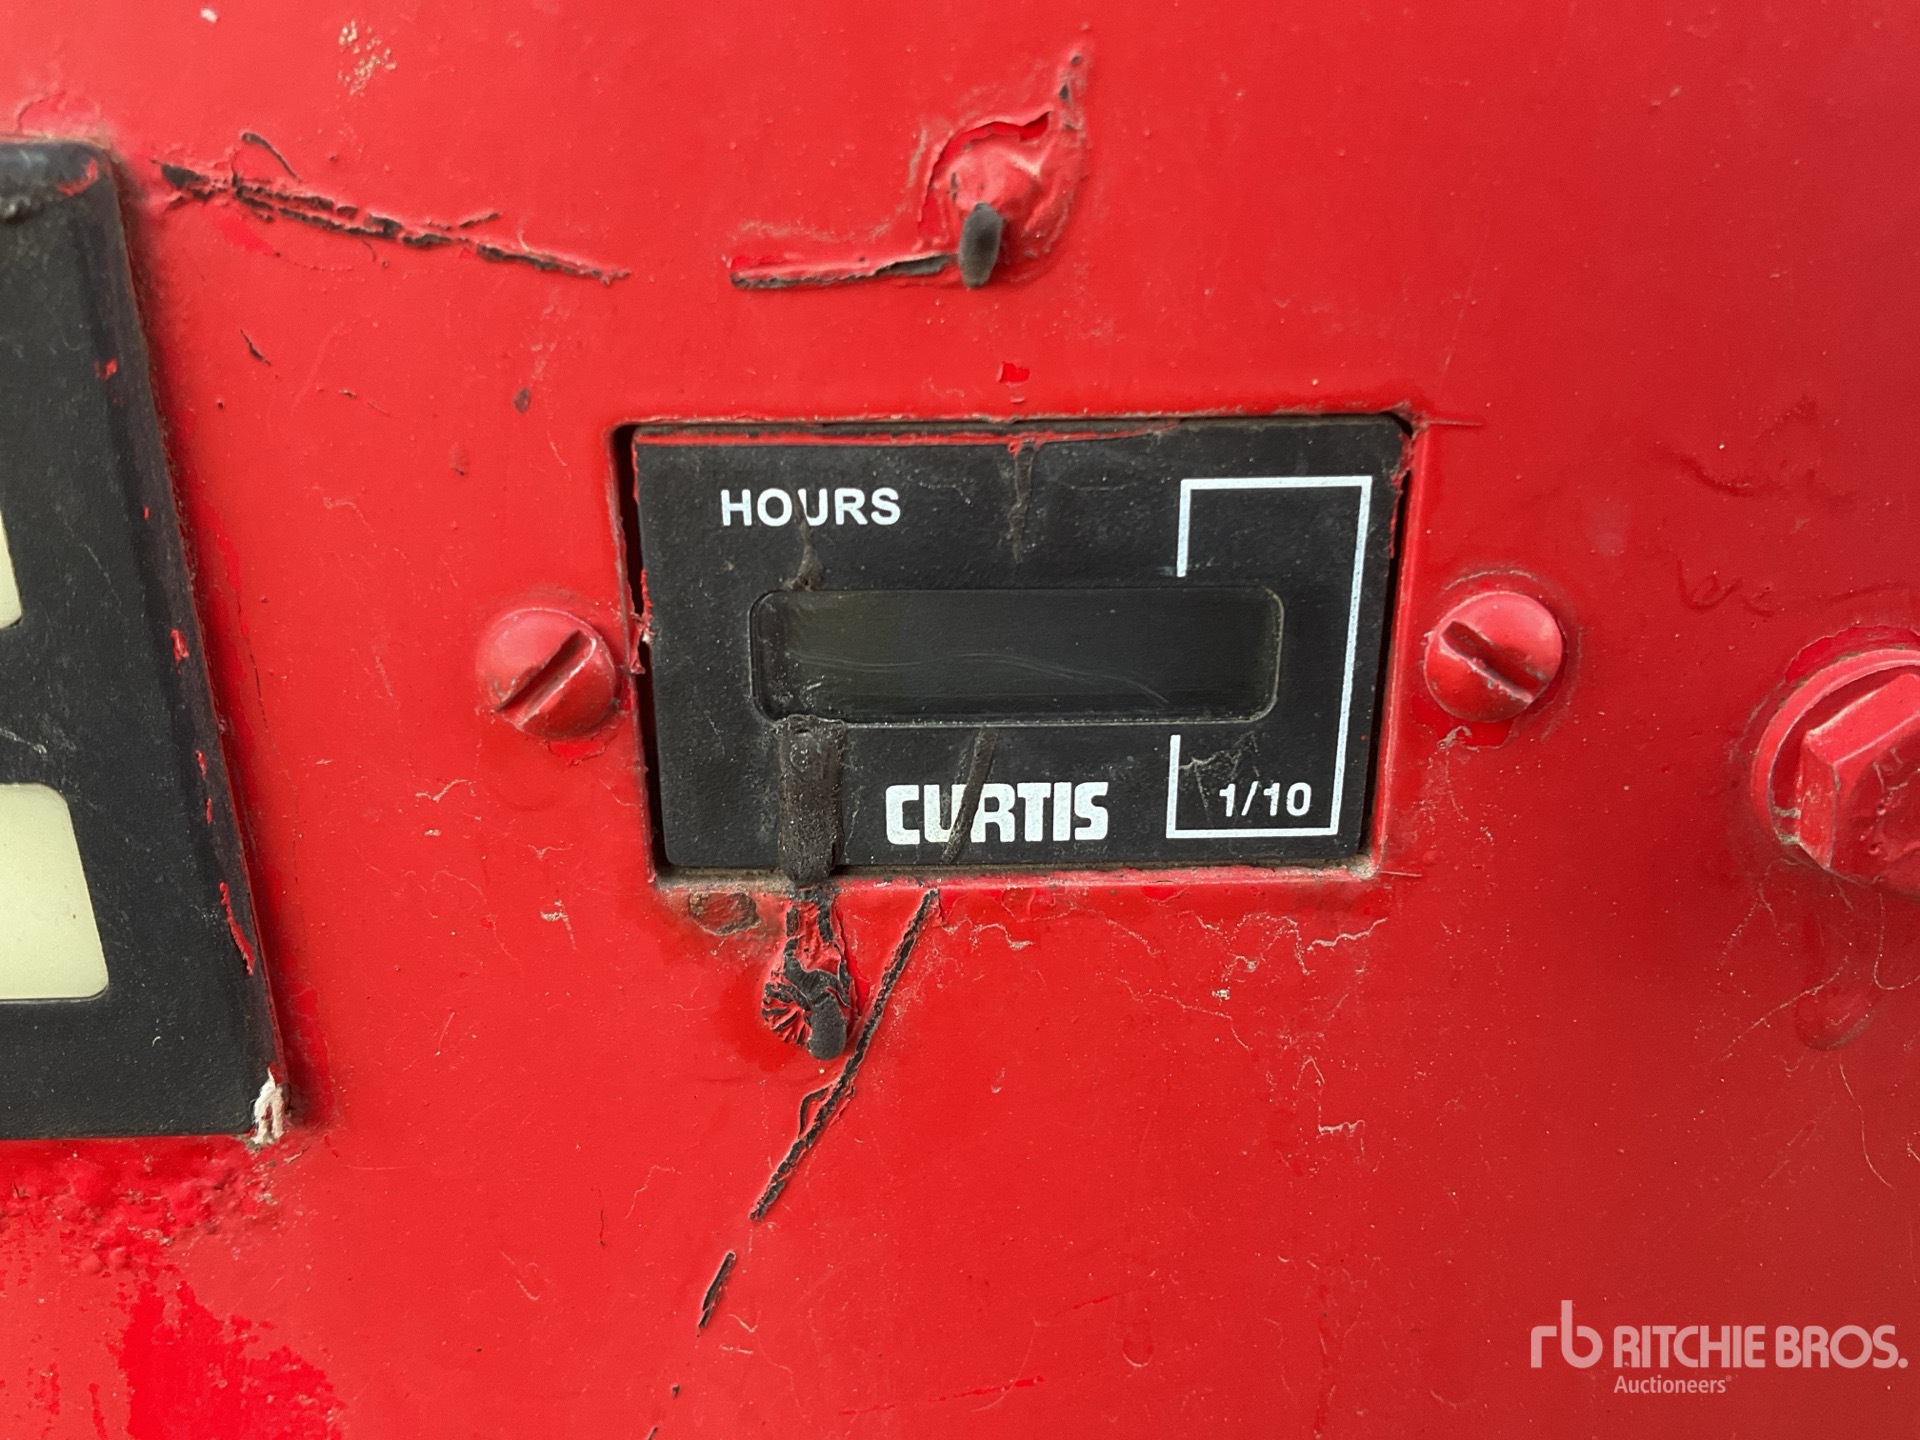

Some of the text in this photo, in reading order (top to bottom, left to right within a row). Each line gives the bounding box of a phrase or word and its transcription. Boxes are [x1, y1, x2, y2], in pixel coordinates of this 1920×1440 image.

[720, 487, 901, 527] HOURS
[885, 781, 1109, 846] CURTIS
[1218, 781, 1312, 818] 1/10
